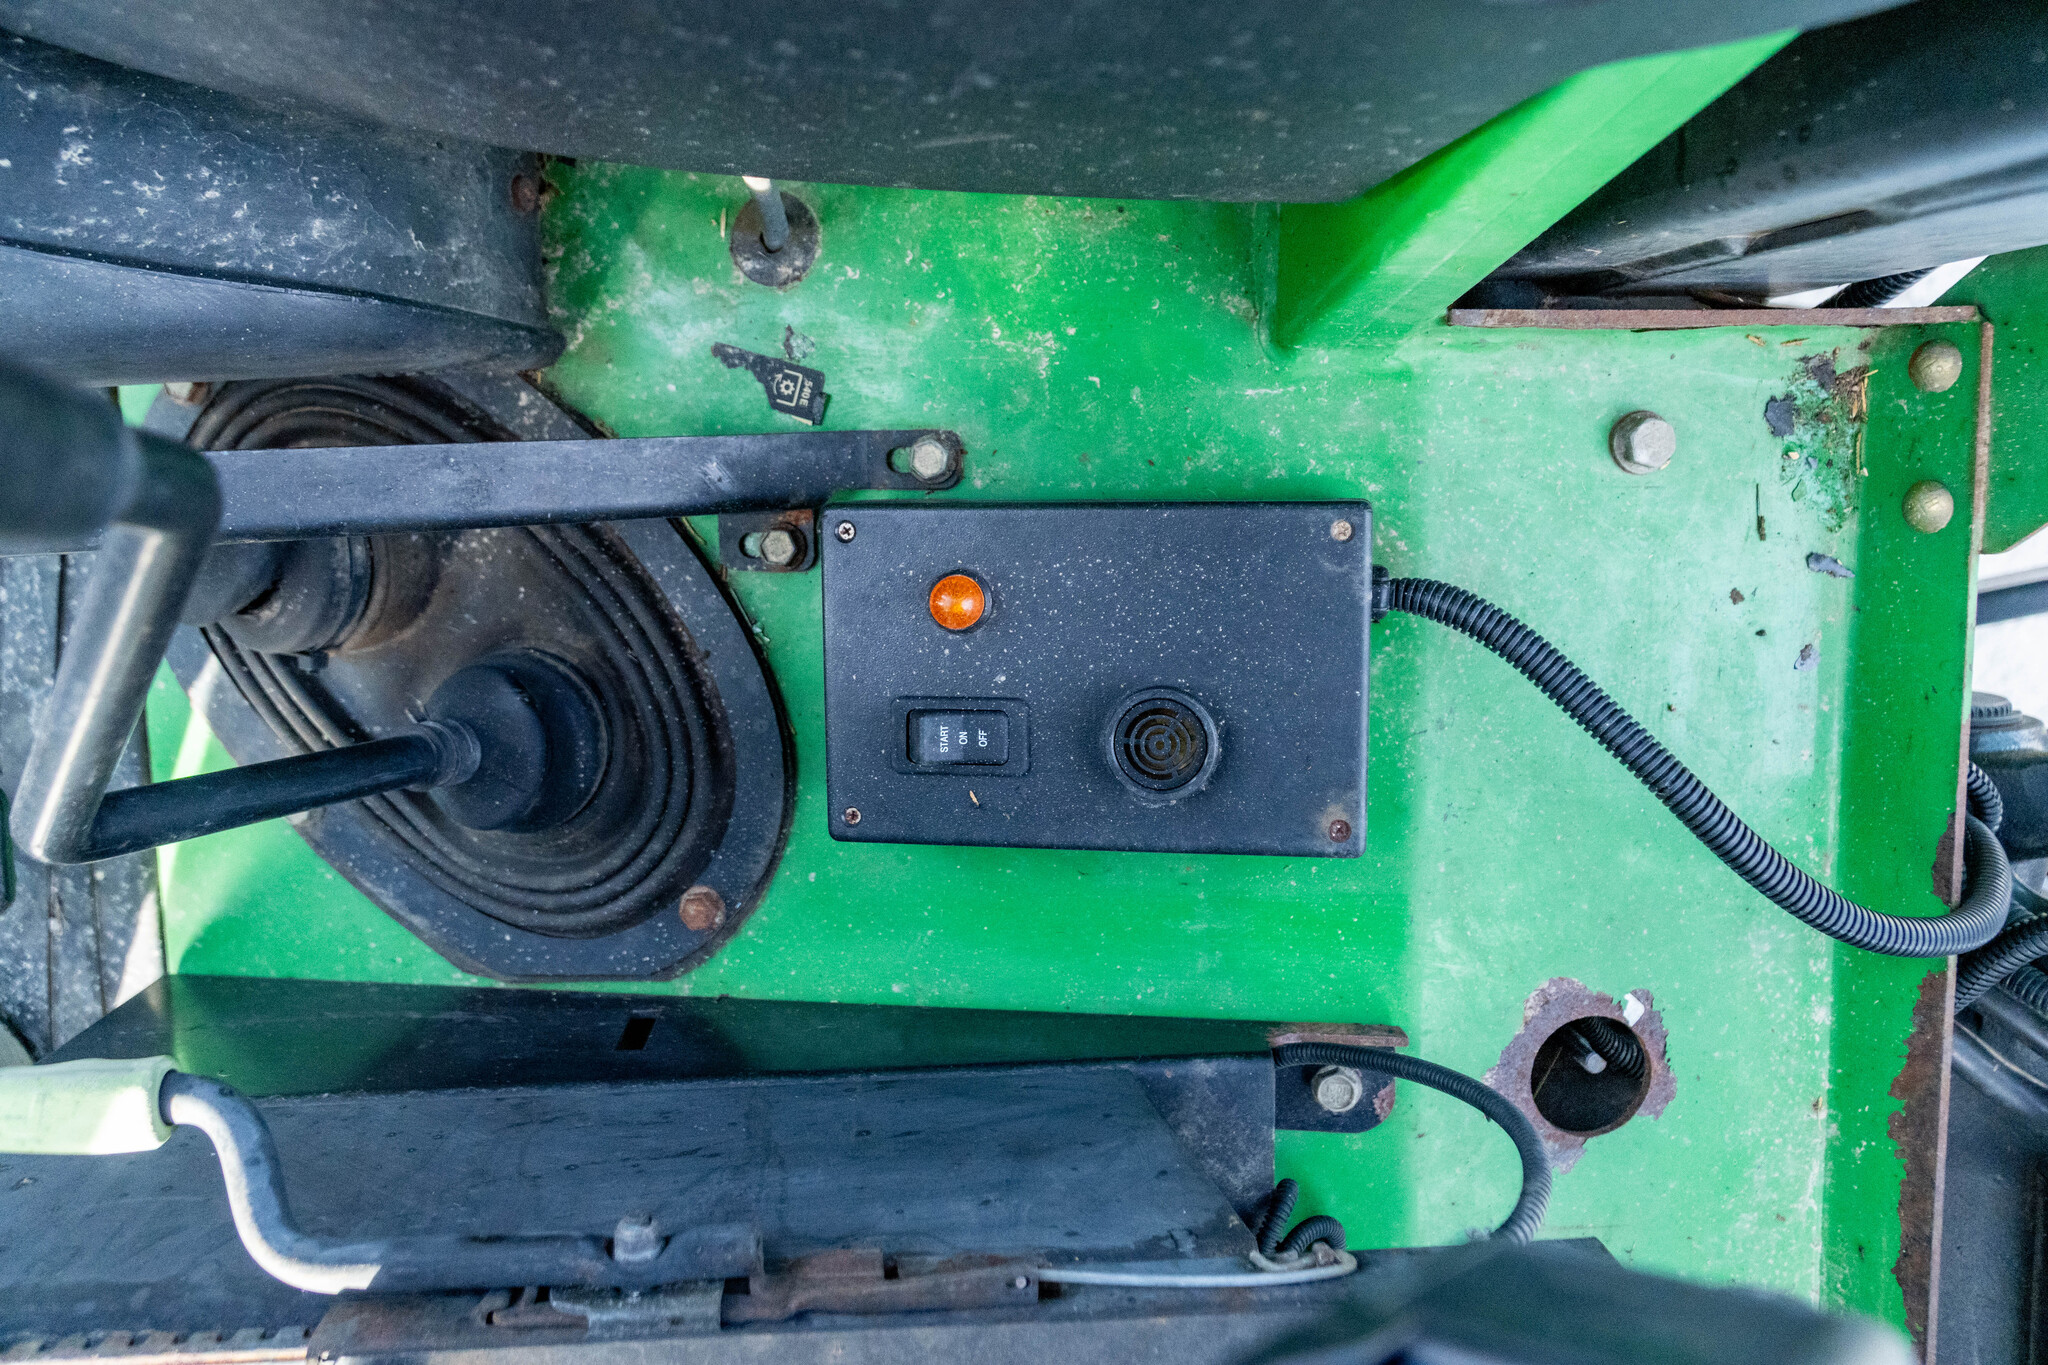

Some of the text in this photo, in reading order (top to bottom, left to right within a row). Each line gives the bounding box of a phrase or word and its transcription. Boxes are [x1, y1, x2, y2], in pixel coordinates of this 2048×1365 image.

[799, 379, 813, 407] 540E
[940, 725, 949, 753] START
[959, 731, 968, 745] ON
[978, 729, 988, 747] OFF
